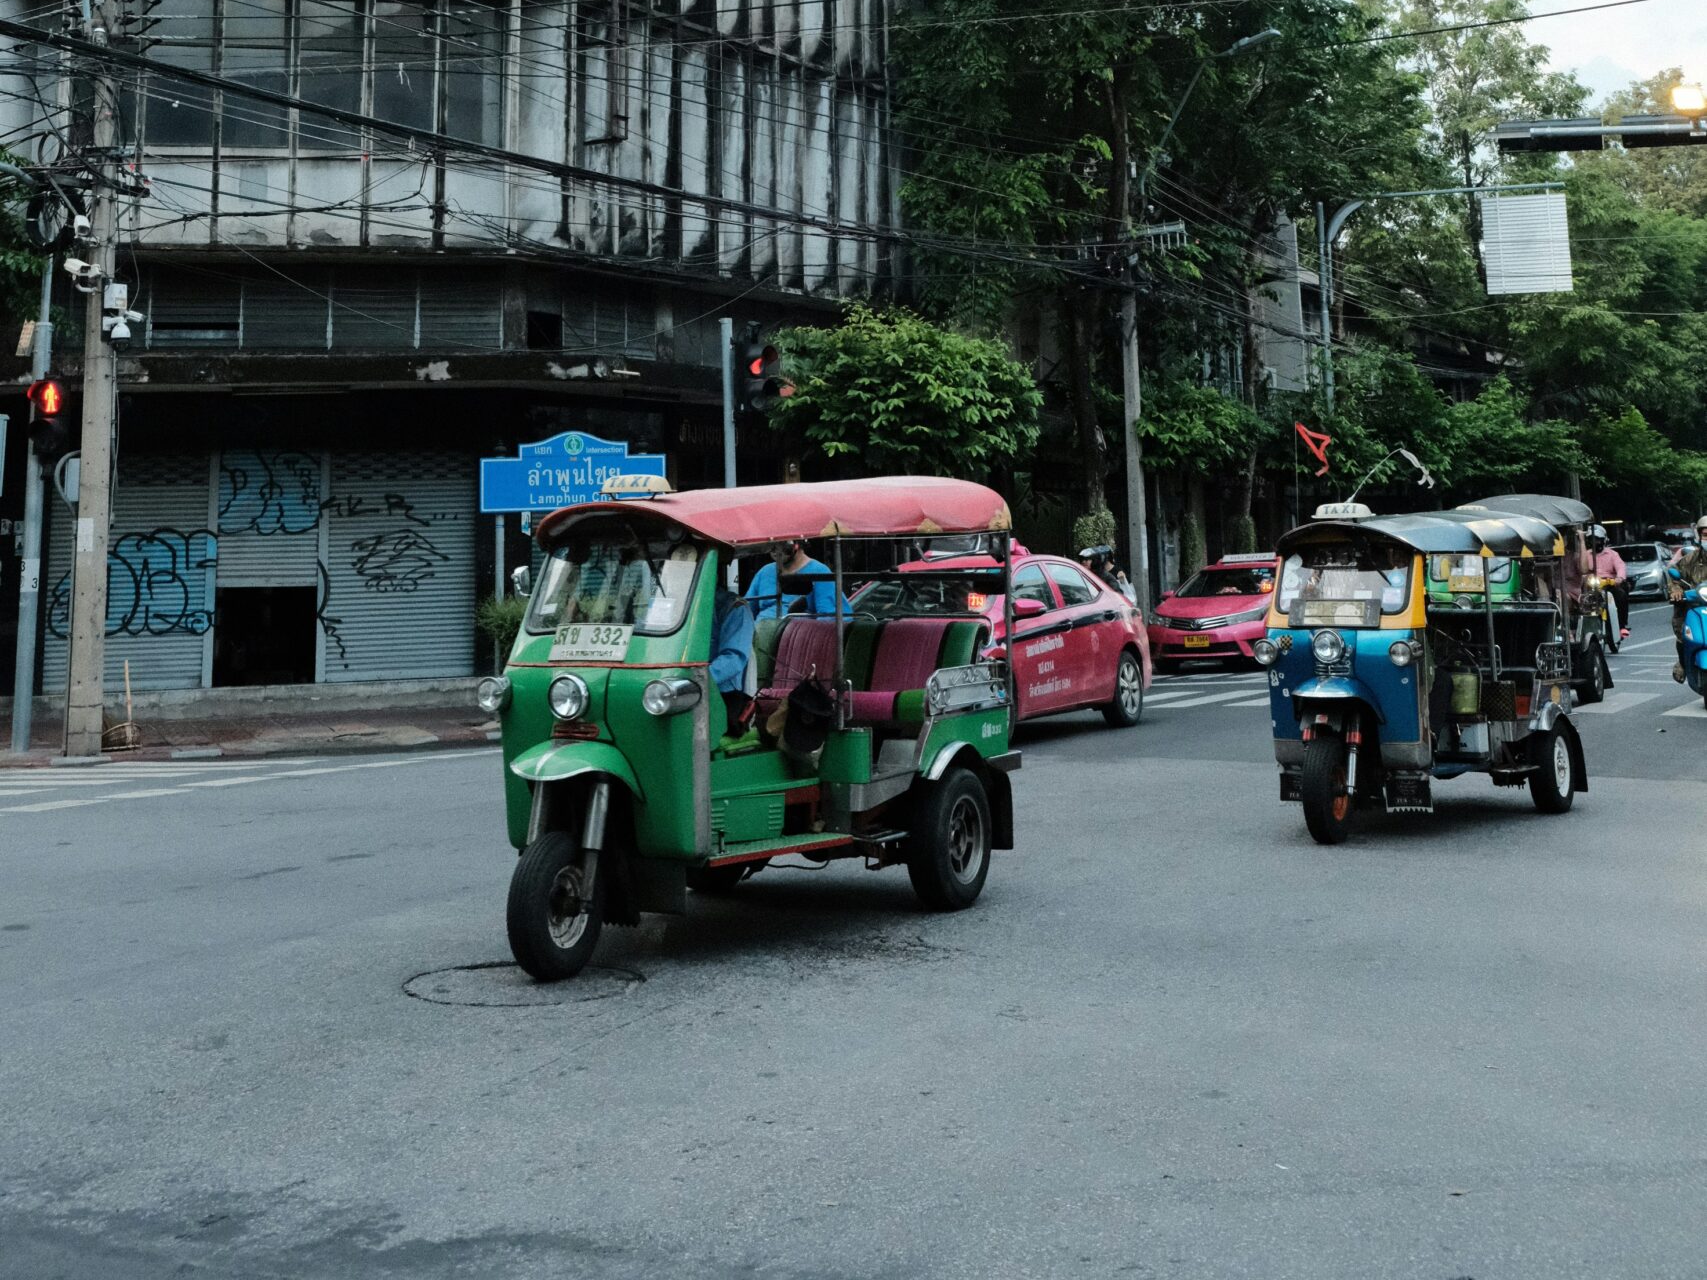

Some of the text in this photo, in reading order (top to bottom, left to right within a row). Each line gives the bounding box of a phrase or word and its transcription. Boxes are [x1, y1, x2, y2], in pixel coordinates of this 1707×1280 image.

[534, 446, 552, 455] แยก
[609, 477, 651, 488] TAXI
[529, 493, 586, 506] Lamphun
[1323, 504, 1357, 514] TAXI
[32, 577, 38, 589] 3
[590, 627, 623, 645] 332
